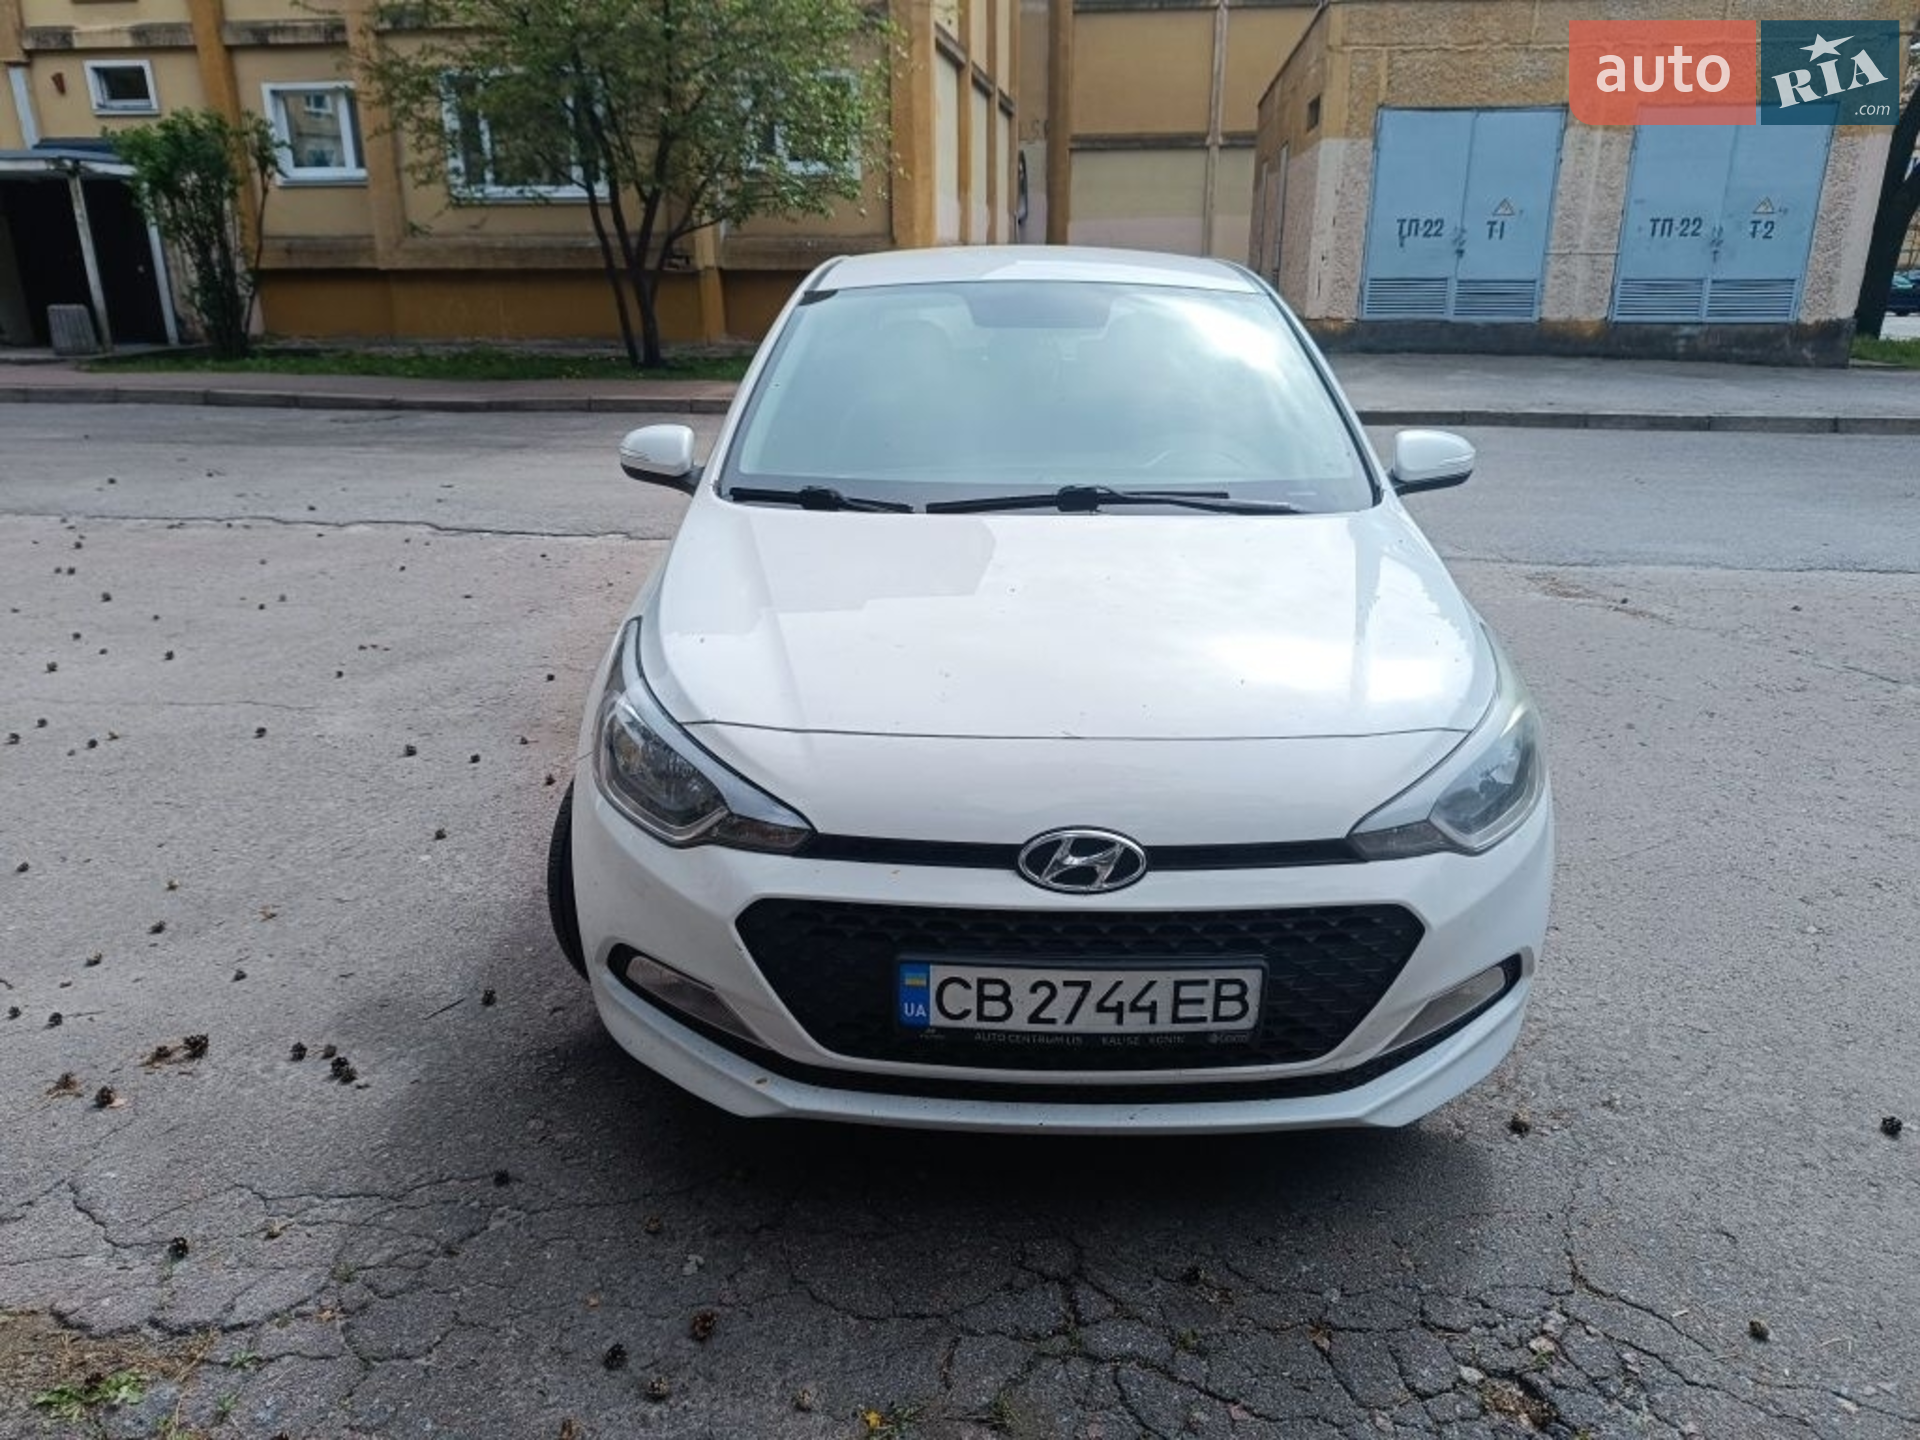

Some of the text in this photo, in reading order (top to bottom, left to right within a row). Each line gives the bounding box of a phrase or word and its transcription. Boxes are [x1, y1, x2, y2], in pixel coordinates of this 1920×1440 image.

[935, 976, 1250, 1026] CB 2744 EB
[904, 1003, 927, 1018] UA
[974, 1032, 1006, 1043] AUTO
